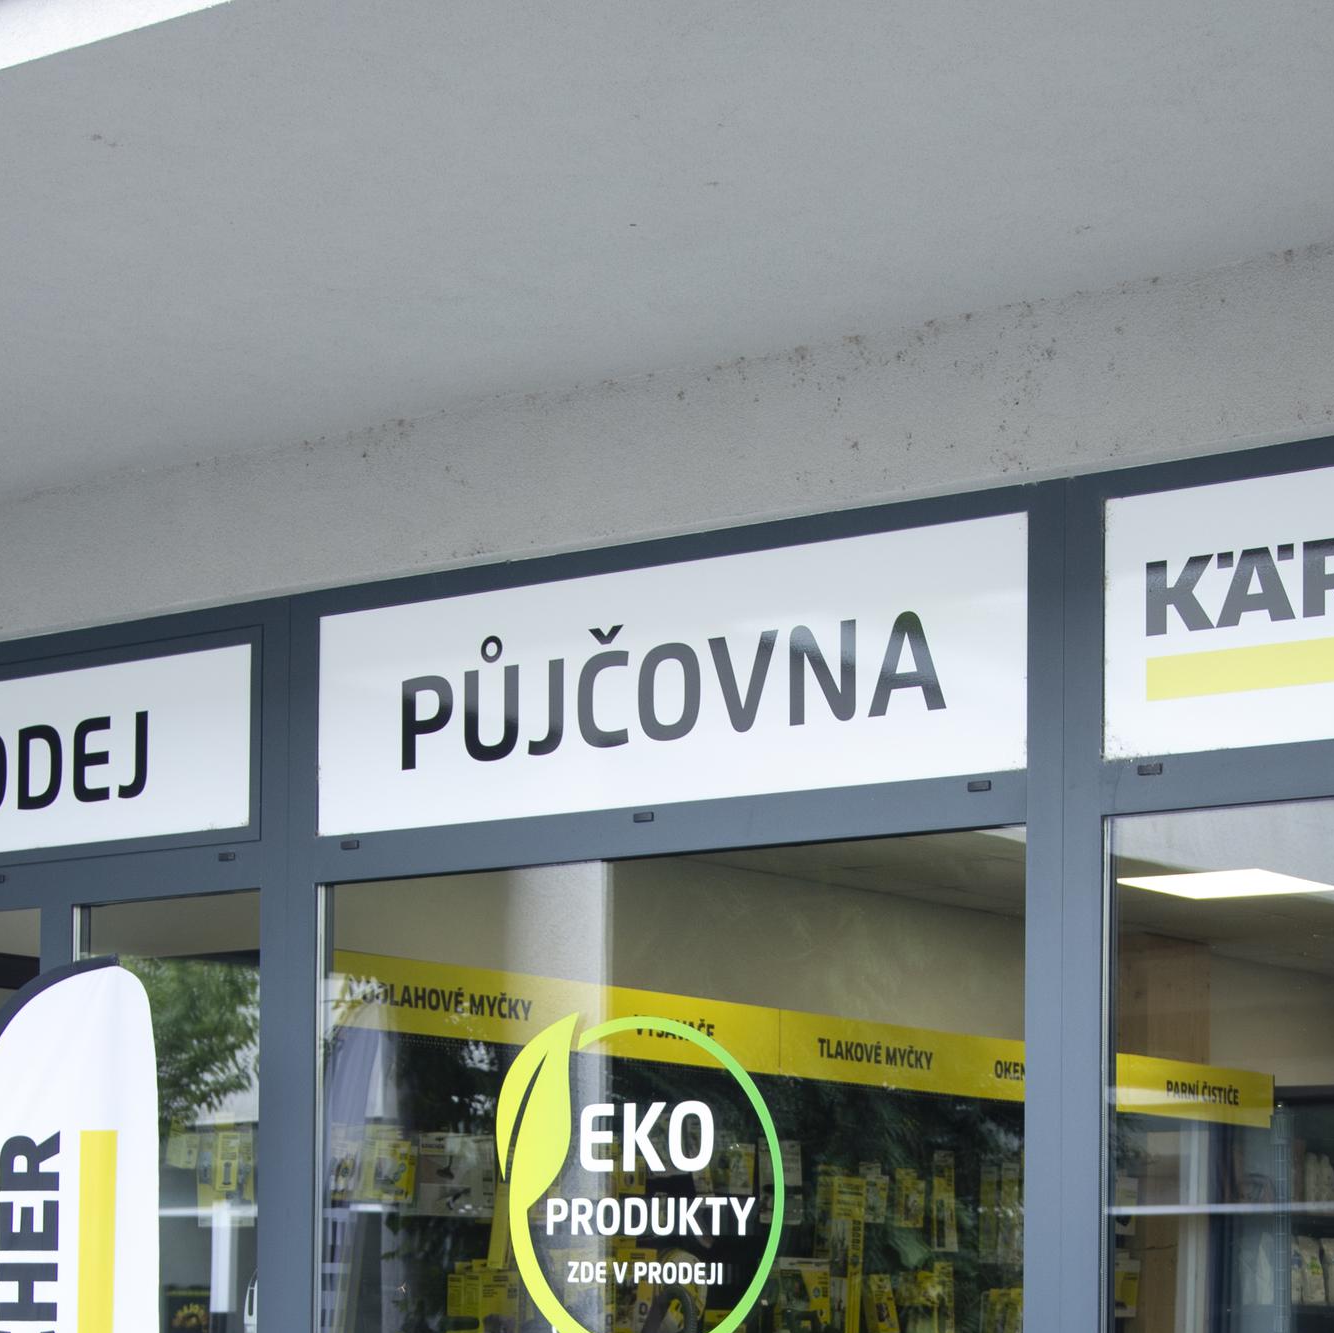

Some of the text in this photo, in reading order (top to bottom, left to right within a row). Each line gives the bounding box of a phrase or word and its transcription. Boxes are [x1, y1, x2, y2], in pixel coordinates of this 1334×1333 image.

[400, 610, 947, 771] PŮJČOVNA
[469, 991, 533, 1021] MYČKY
[817, 1037, 934, 1071] TLAKOVÉ MYČKY
[1166, 1079, 1240, 1107] PARNÍ ČISTIČE
[577, 1099, 716, 1174] EKO
[545, 1196, 756, 1238] PRODUKTY
[567, 1260, 725, 1286] ZDE V PRODEJI
